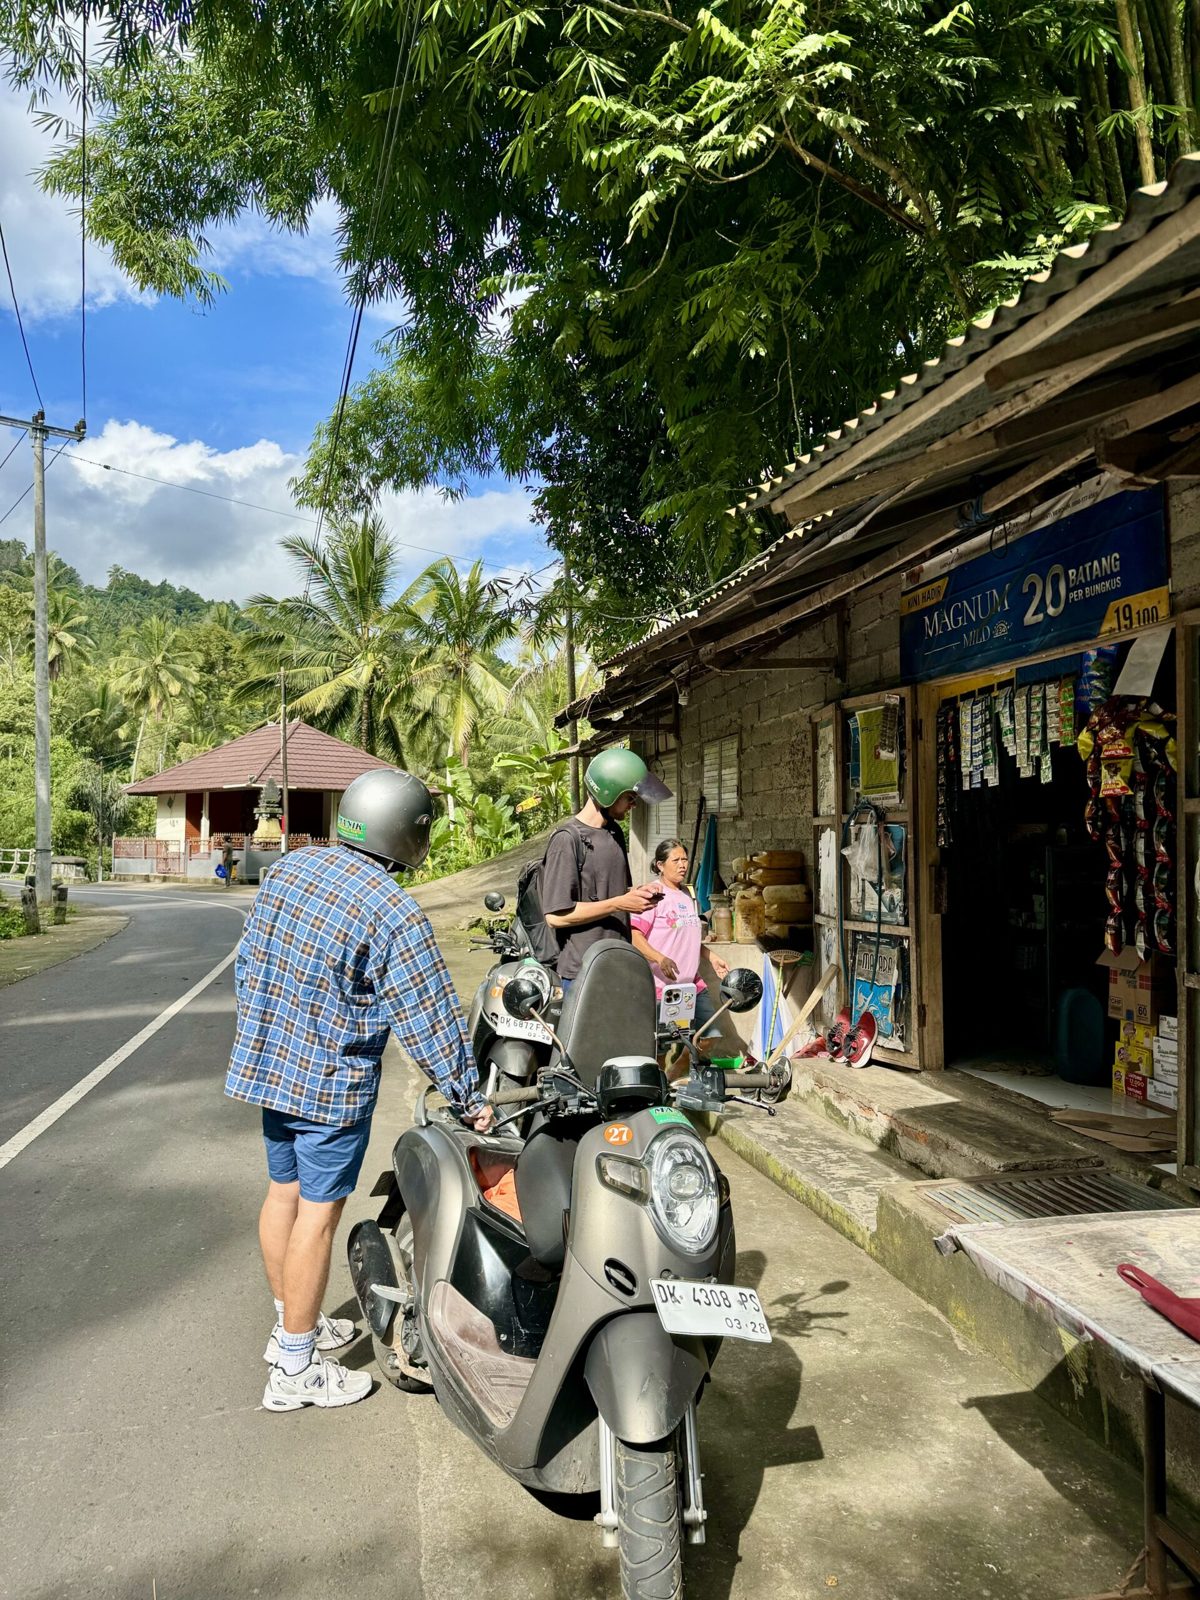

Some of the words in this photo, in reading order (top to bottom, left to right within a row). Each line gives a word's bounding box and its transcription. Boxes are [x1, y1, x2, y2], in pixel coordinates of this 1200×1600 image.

[1068, 552, 1121, 589] BATANG
[1022, 563, 1067, 627] 20
[1068, 590, 1084, 604] PER
[1085, 576, 1122, 599] BUNGKUS
[923, 582, 1011, 641] MAGNUM
[962, 625, 991, 649] MILD
[500, 1016, 511, 1025] DK
[608, 1127, 629, 1142] 27
[656, 1283, 682, 1305] DK
[692, 1287, 732, 1309] 4308
[738, 1291, 761, 1313] PS
